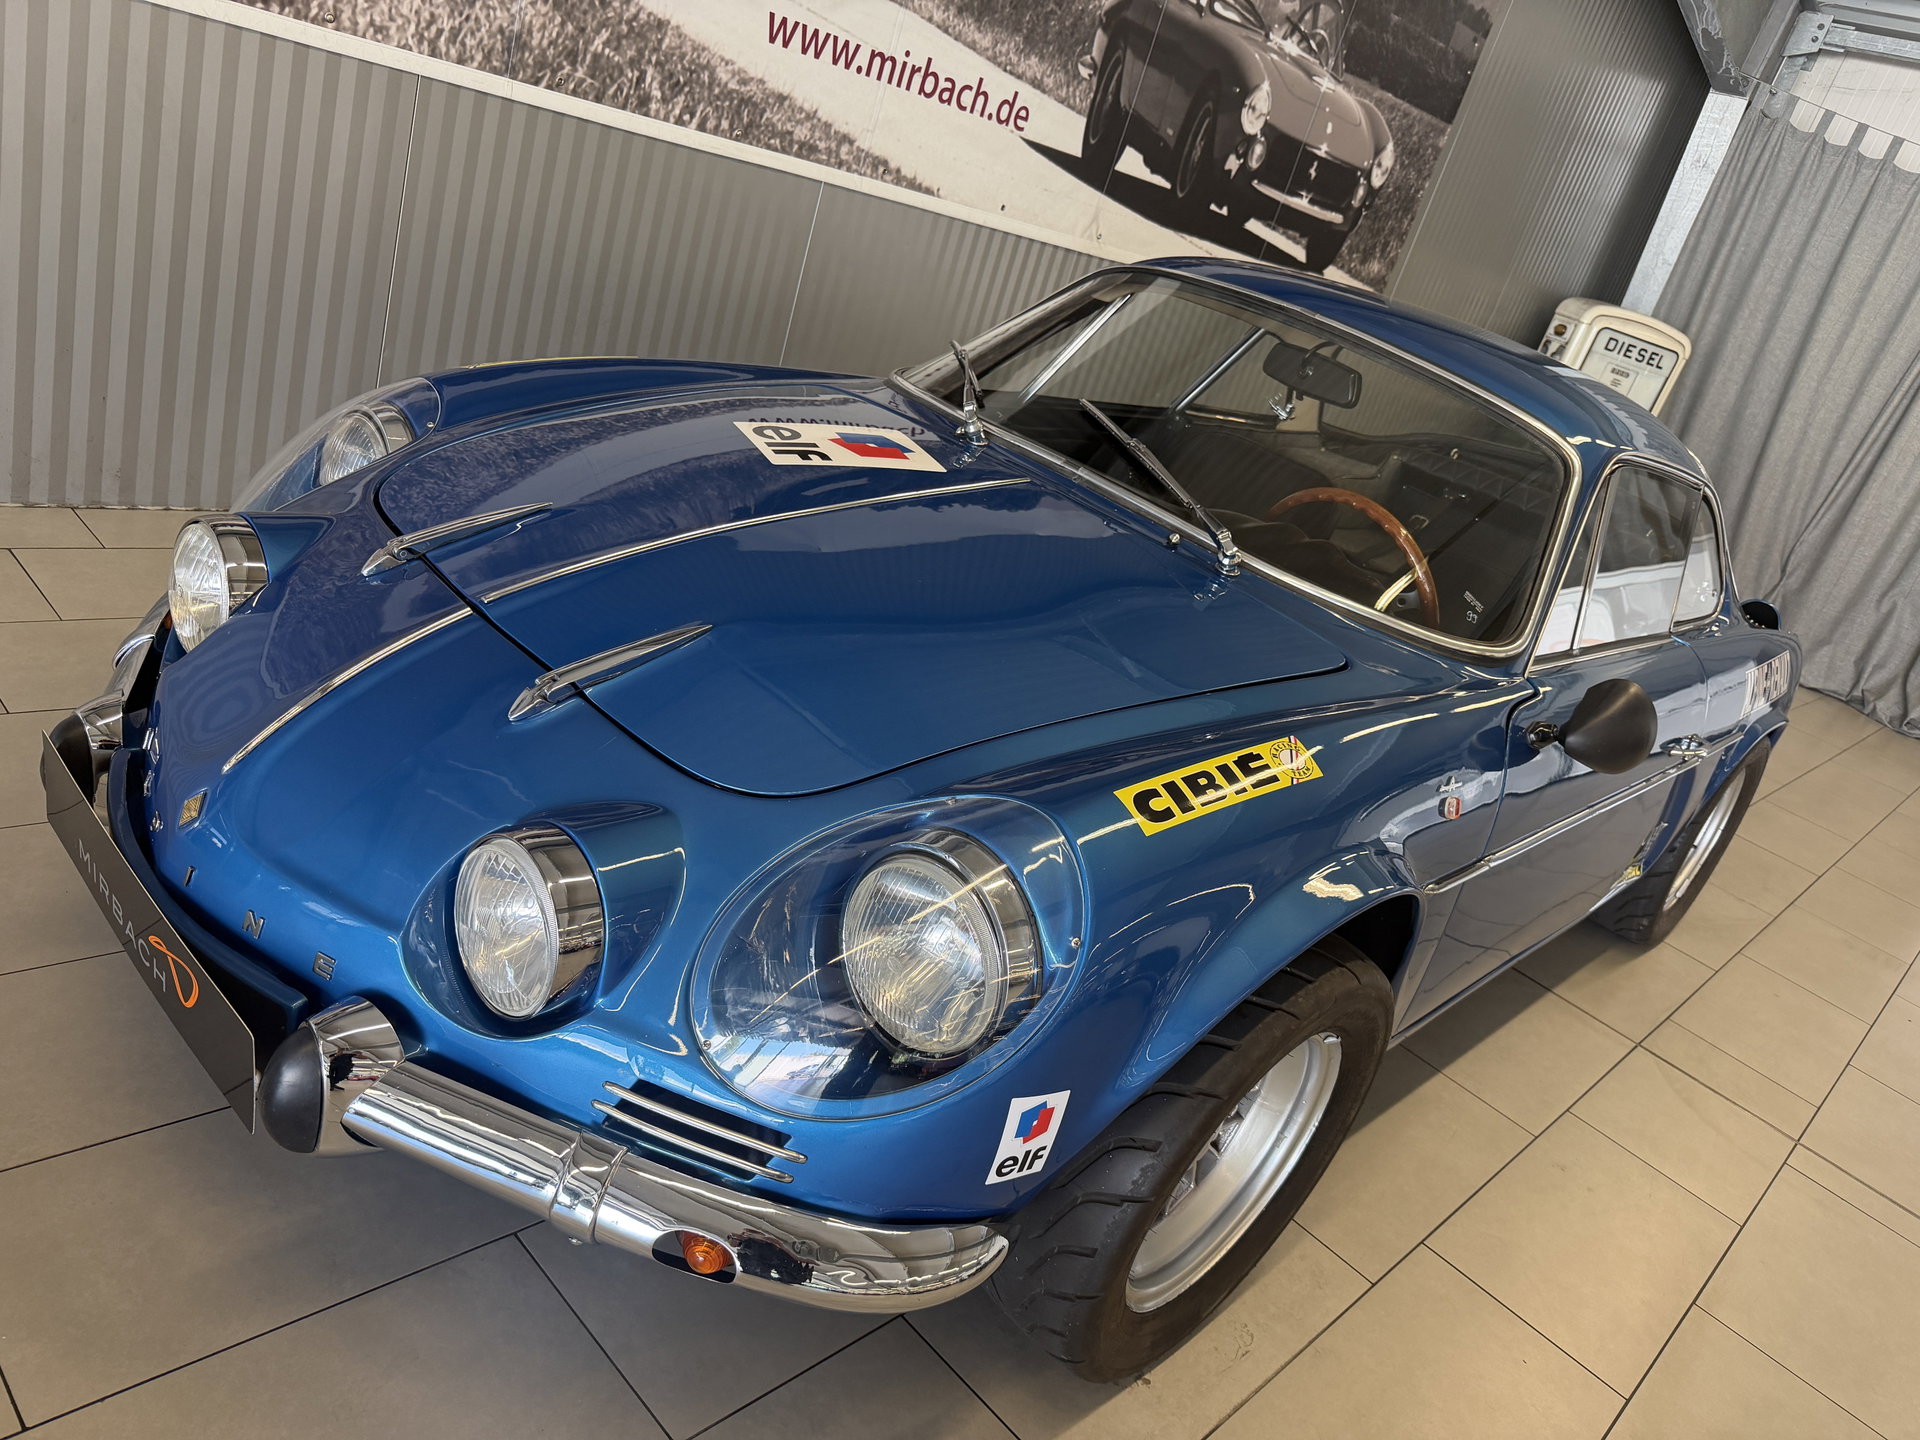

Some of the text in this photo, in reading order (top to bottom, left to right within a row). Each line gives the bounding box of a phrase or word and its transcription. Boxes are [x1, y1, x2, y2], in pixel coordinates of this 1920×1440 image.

[766, 11, 1031, 132] www.mirbach.de
[1604, 337, 1664, 370] DIESEL
[751, 425, 833, 462] elf
[78, 838, 167, 993] MIRBACH
[995, 1145, 1048, 1178] elf
